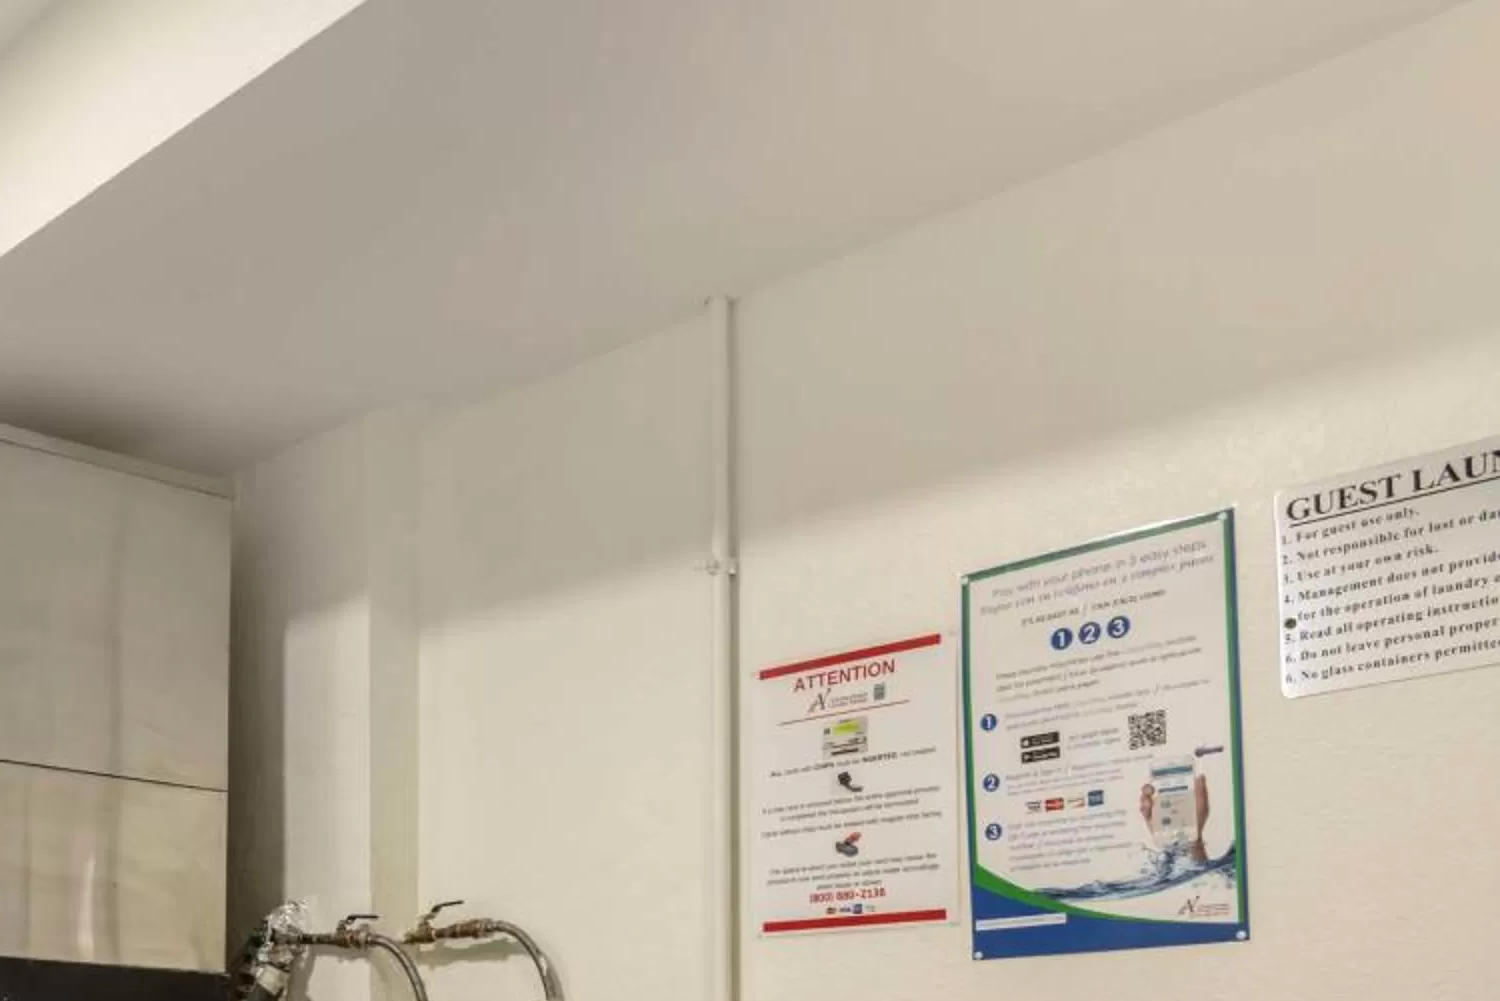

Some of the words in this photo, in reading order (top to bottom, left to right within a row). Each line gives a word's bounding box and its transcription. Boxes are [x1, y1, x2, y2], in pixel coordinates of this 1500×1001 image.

[1286, 473, 1402, 521] GUEST
[1296, 530, 1318, 543] For
[1322, 521, 1357, 538] guest
[1361, 516, 1381, 528] use
[1297, 549, 1319, 560] Not
[1323, 532, 1400, 556] responsible
[1404, 527, 1424, 538] for
[1429, 519, 1453, 532] lost
[1459, 515, 1475, 526] or
[1297, 571, 1320, 581] Use
[1324, 565, 1336, 576] at
[1341, 560, 1369, 576] your
[1375, 552, 1402, 564] own
[1298, 576, 1382, 600] Management
[1388, 571, 1417, 584] does
[1421, 563, 1444, 576] not
[1298, 611, 1316, 621] for
[1320, 606, 1340, 617] the
[1344, 593, 1410, 614] operation
[1414, 585, 1428, 598] of
[1432, 577, 1488, 595] laundry
[1300, 626, 1331, 640] Read
[1336, 622, 1353, 634] all
[1356, 611, 1423, 632] operating
[1301, 650, 1317, 660] Do
[1321, 645, 1341, 656] not
[1346, 640, 1380, 653] leave
[1384, 625, 1444, 649] personal
[794, 659, 896, 692] ATTENTION
[1302, 671, 1318, 680] No
[1322, 666, 1354, 679] glass
[1357, 652, 1429, 671] containers
